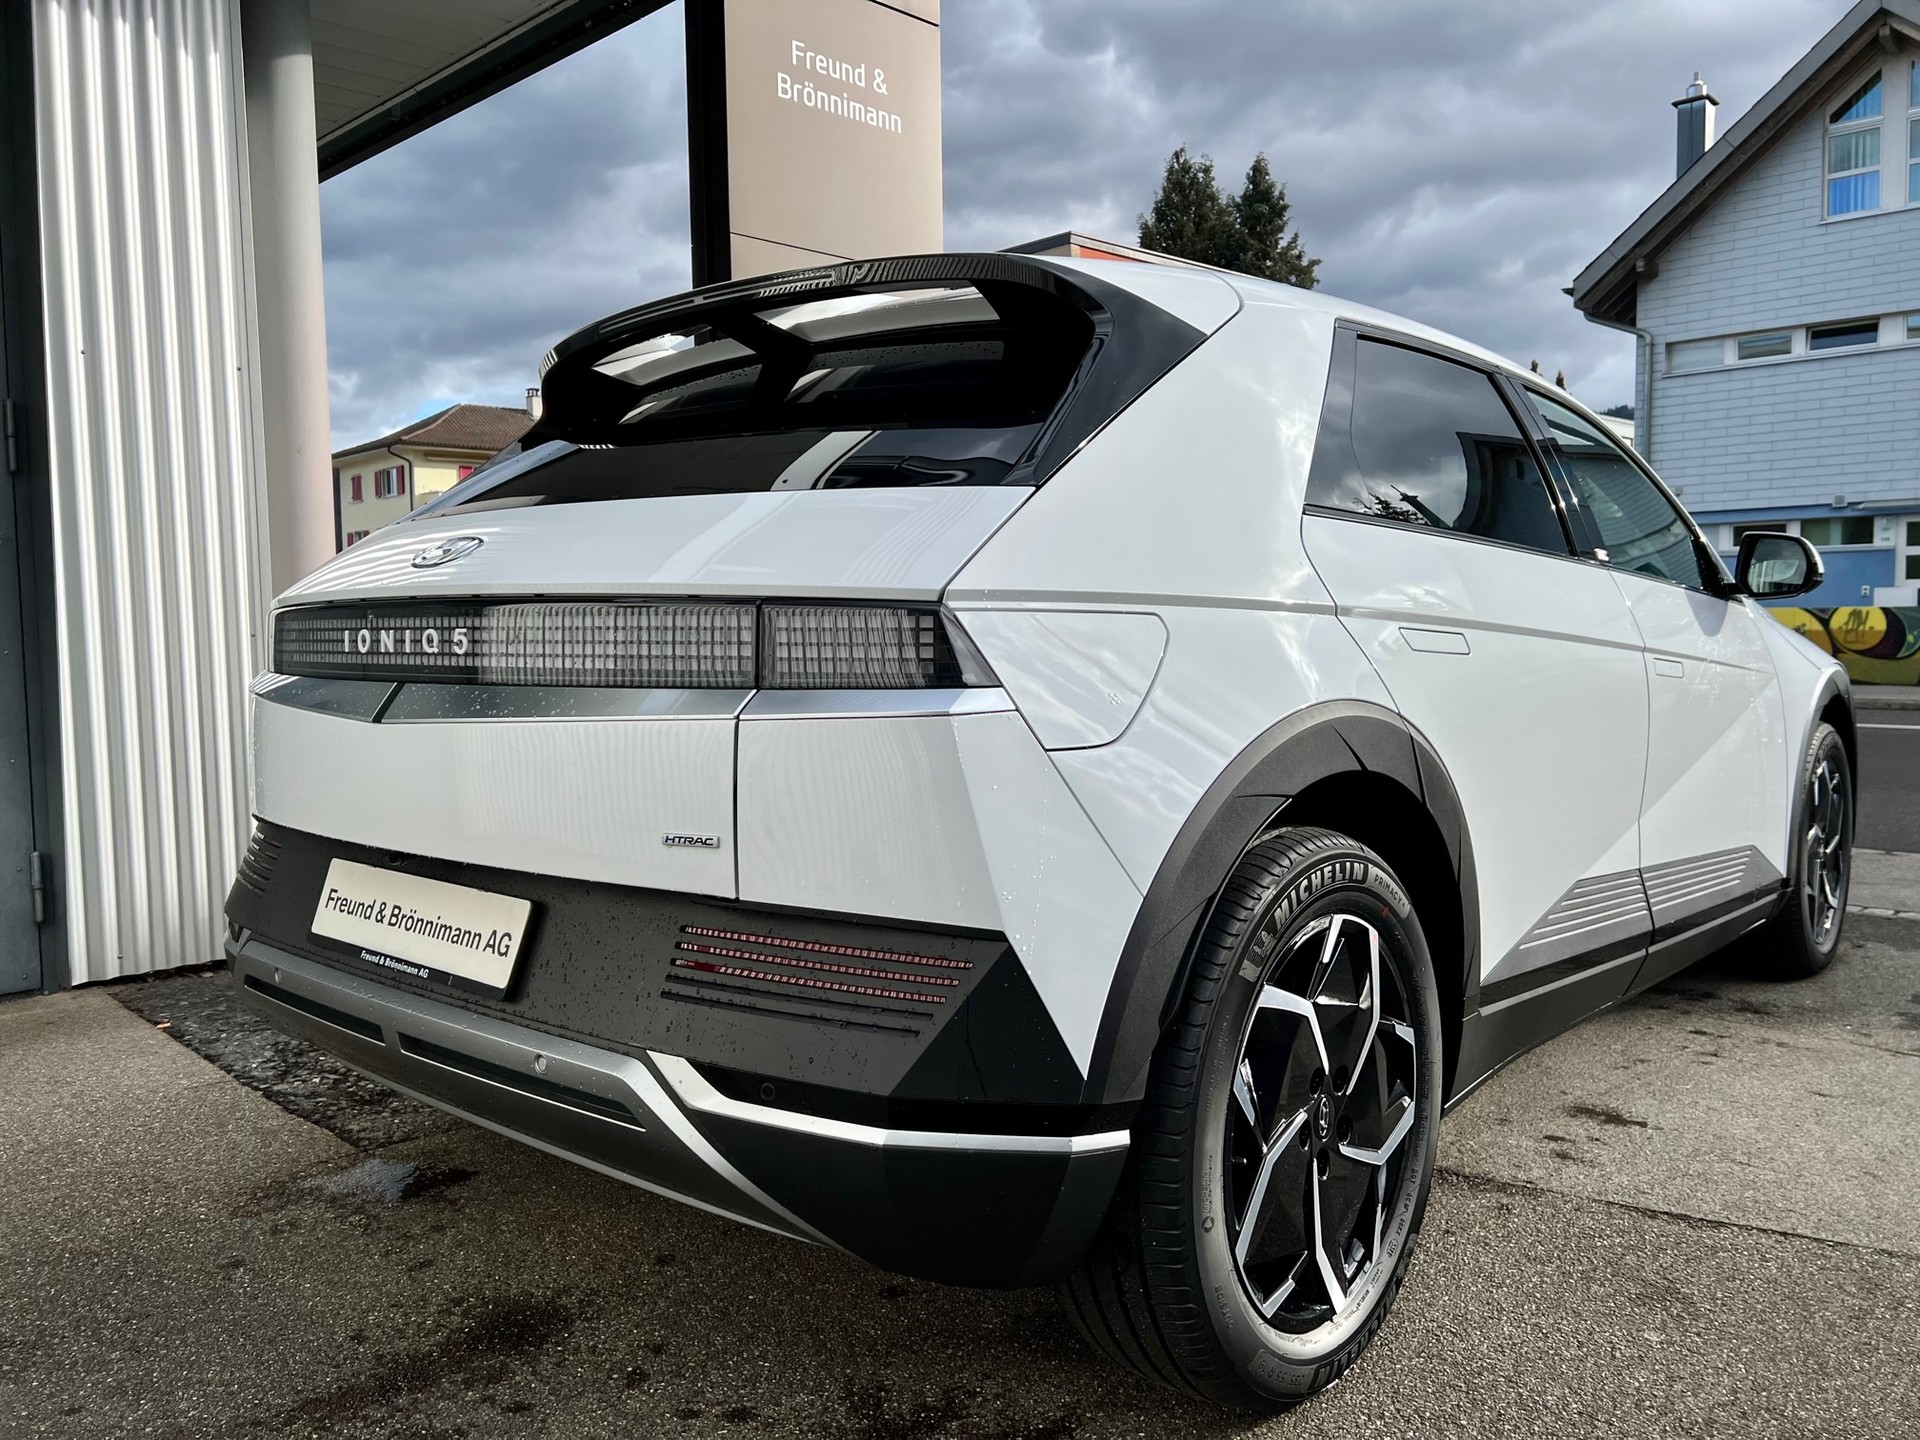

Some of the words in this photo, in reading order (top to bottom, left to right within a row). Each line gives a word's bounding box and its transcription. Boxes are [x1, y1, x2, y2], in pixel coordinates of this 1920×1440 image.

[791, 39, 866, 88] Freund
[872, 68, 889, 96] &
[776, 71, 903, 135] Brönnimann
[344, 628, 440, 654] IONIQ
[452, 627, 469, 655] 5
[664, 835, 714, 846] HTRAC
[324, 888, 377, 920] Freund
[375, 901, 388, 925] &
[387, 905, 488, 951] Brönnimann
[484, 929, 513, 958] AG
[1273, 861, 1365, 932] MICHELIN
[1374, 873, 1402, 905] PRIMACY
[360, 950, 380, 964] Freund
[379, 955, 385, 965] &
[384, 957, 419, 975] Brönnimann
[418, 967, 430, 979] AG
